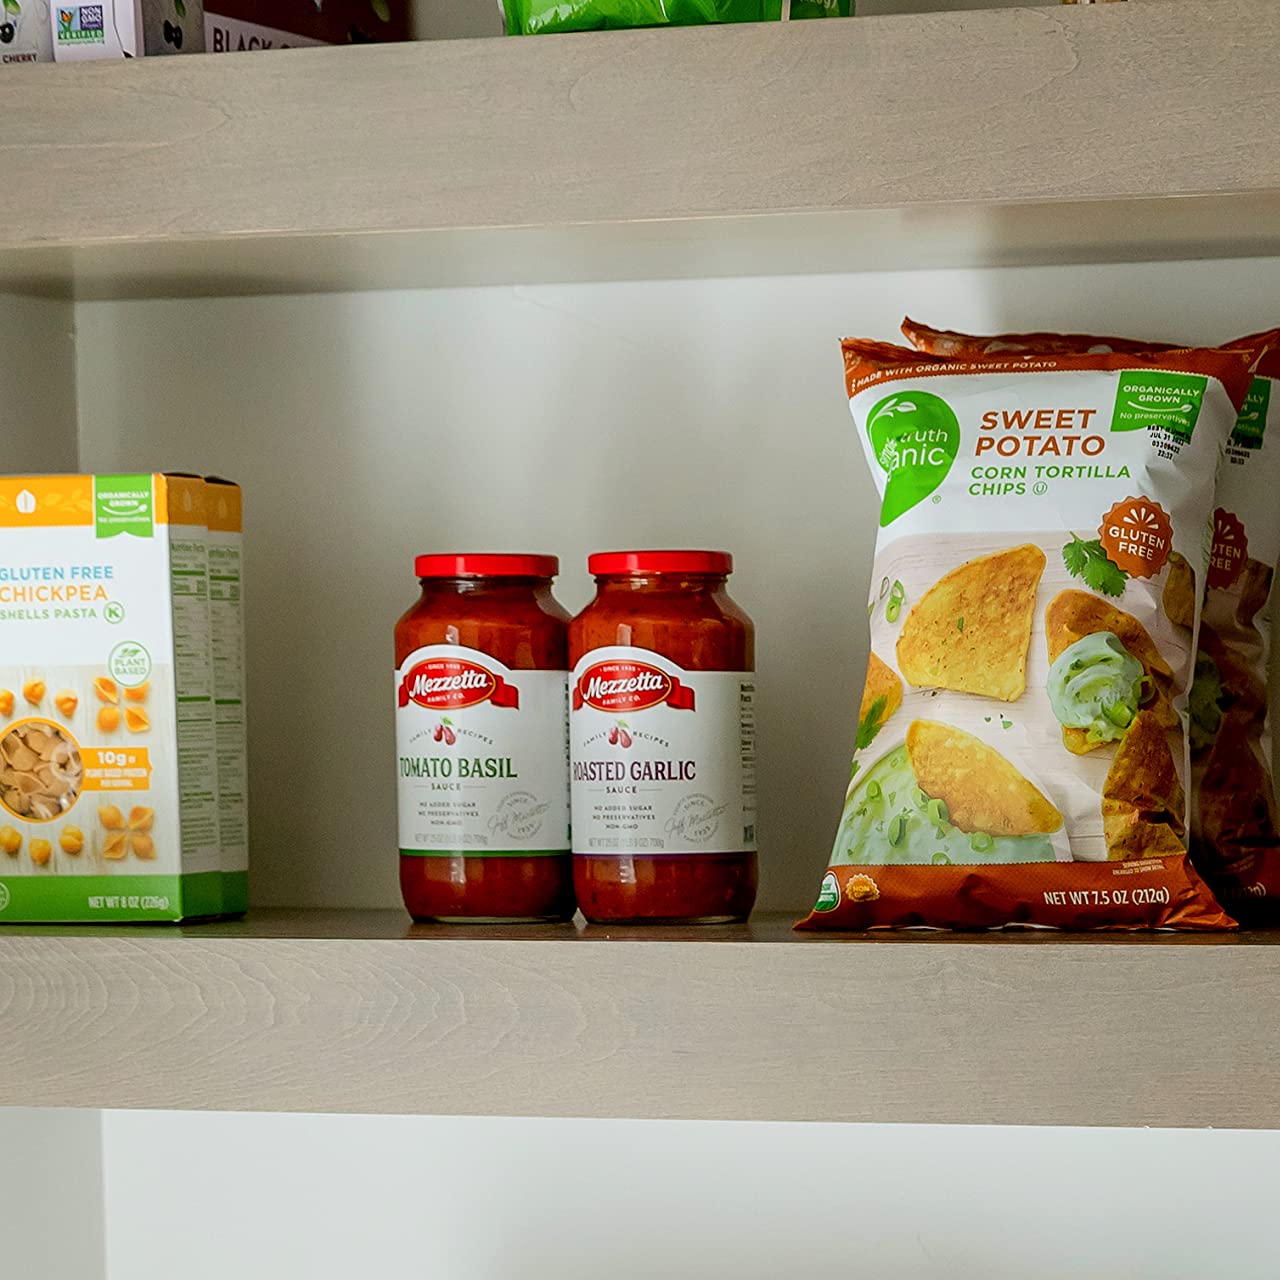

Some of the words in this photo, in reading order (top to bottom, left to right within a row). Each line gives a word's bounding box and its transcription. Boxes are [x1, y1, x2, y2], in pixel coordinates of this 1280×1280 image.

[2, 53, 37, 63] CHERRY
[856, 372, 882, 387] MADE
[885, 366, 913, 377] WITH
[916, 363, 966, 373] ORGANIC
[970, 362, 1009, 370] SWEET
[1012, 361, 1057, 369] POTATO
[1123, 384, 1200, 397] ORGANICALLY
[1138, 395, 1181, 404] GROWN
[980, 409, 1097, 431] SWEET
[1134, 412, 1190, 426] preservatives
[1163, 433, 1171, 441] 31
[974, 435, 1105, 457] POTATO
[971, 466, 1027, 479] CORN
[1034, 465, 1131, 479] TORTILLA
[968, 482, 1026, 496] CHIPS
[1108, 525, 1165, 550] GLUTEN
[1118, 541, 1154, 561] FREE
[1211, 556, 1232, 571] REE
[0, 567, 65, 581] GLUTEN
[71, 565, 114, 580] FREE
[0, 584, 108, 603] CHICKPEA
[0, 608, 50, 620] SHELLS
[55, 608, 97, 619] PASTA
[115, 658, 146, 666] PLANT
[115, 667, 147, 676] BASED
[409, 669, 488, 698] Mezzetta
[583, 671, 664, 700] Mezzetta
[427, 694, 451, 703] FAMILY
[602, 697, 627, 706] FAMILY
[457, 728, 493, 745] RECIPES
[632, 731, 669, 747] RECIPES
[98, 751, 127, 767] 10g
[399, 757, 452, 778] TOMATO
[457, 757, 518, 778] BASIL
[630, 760, 696, 781] GARLIC
[431, 783, 461, 791] SAUCE
[606, 786, 637, 794] SAUCE
[1043, 891, 1066, 906] NET
[1068, 890, 1090, 905] WT
[1091, 889, 1110, 905] 7.5
[1113, 889, 1129, 904] OZ
[1132, 887, 1170, 906] (212g)
